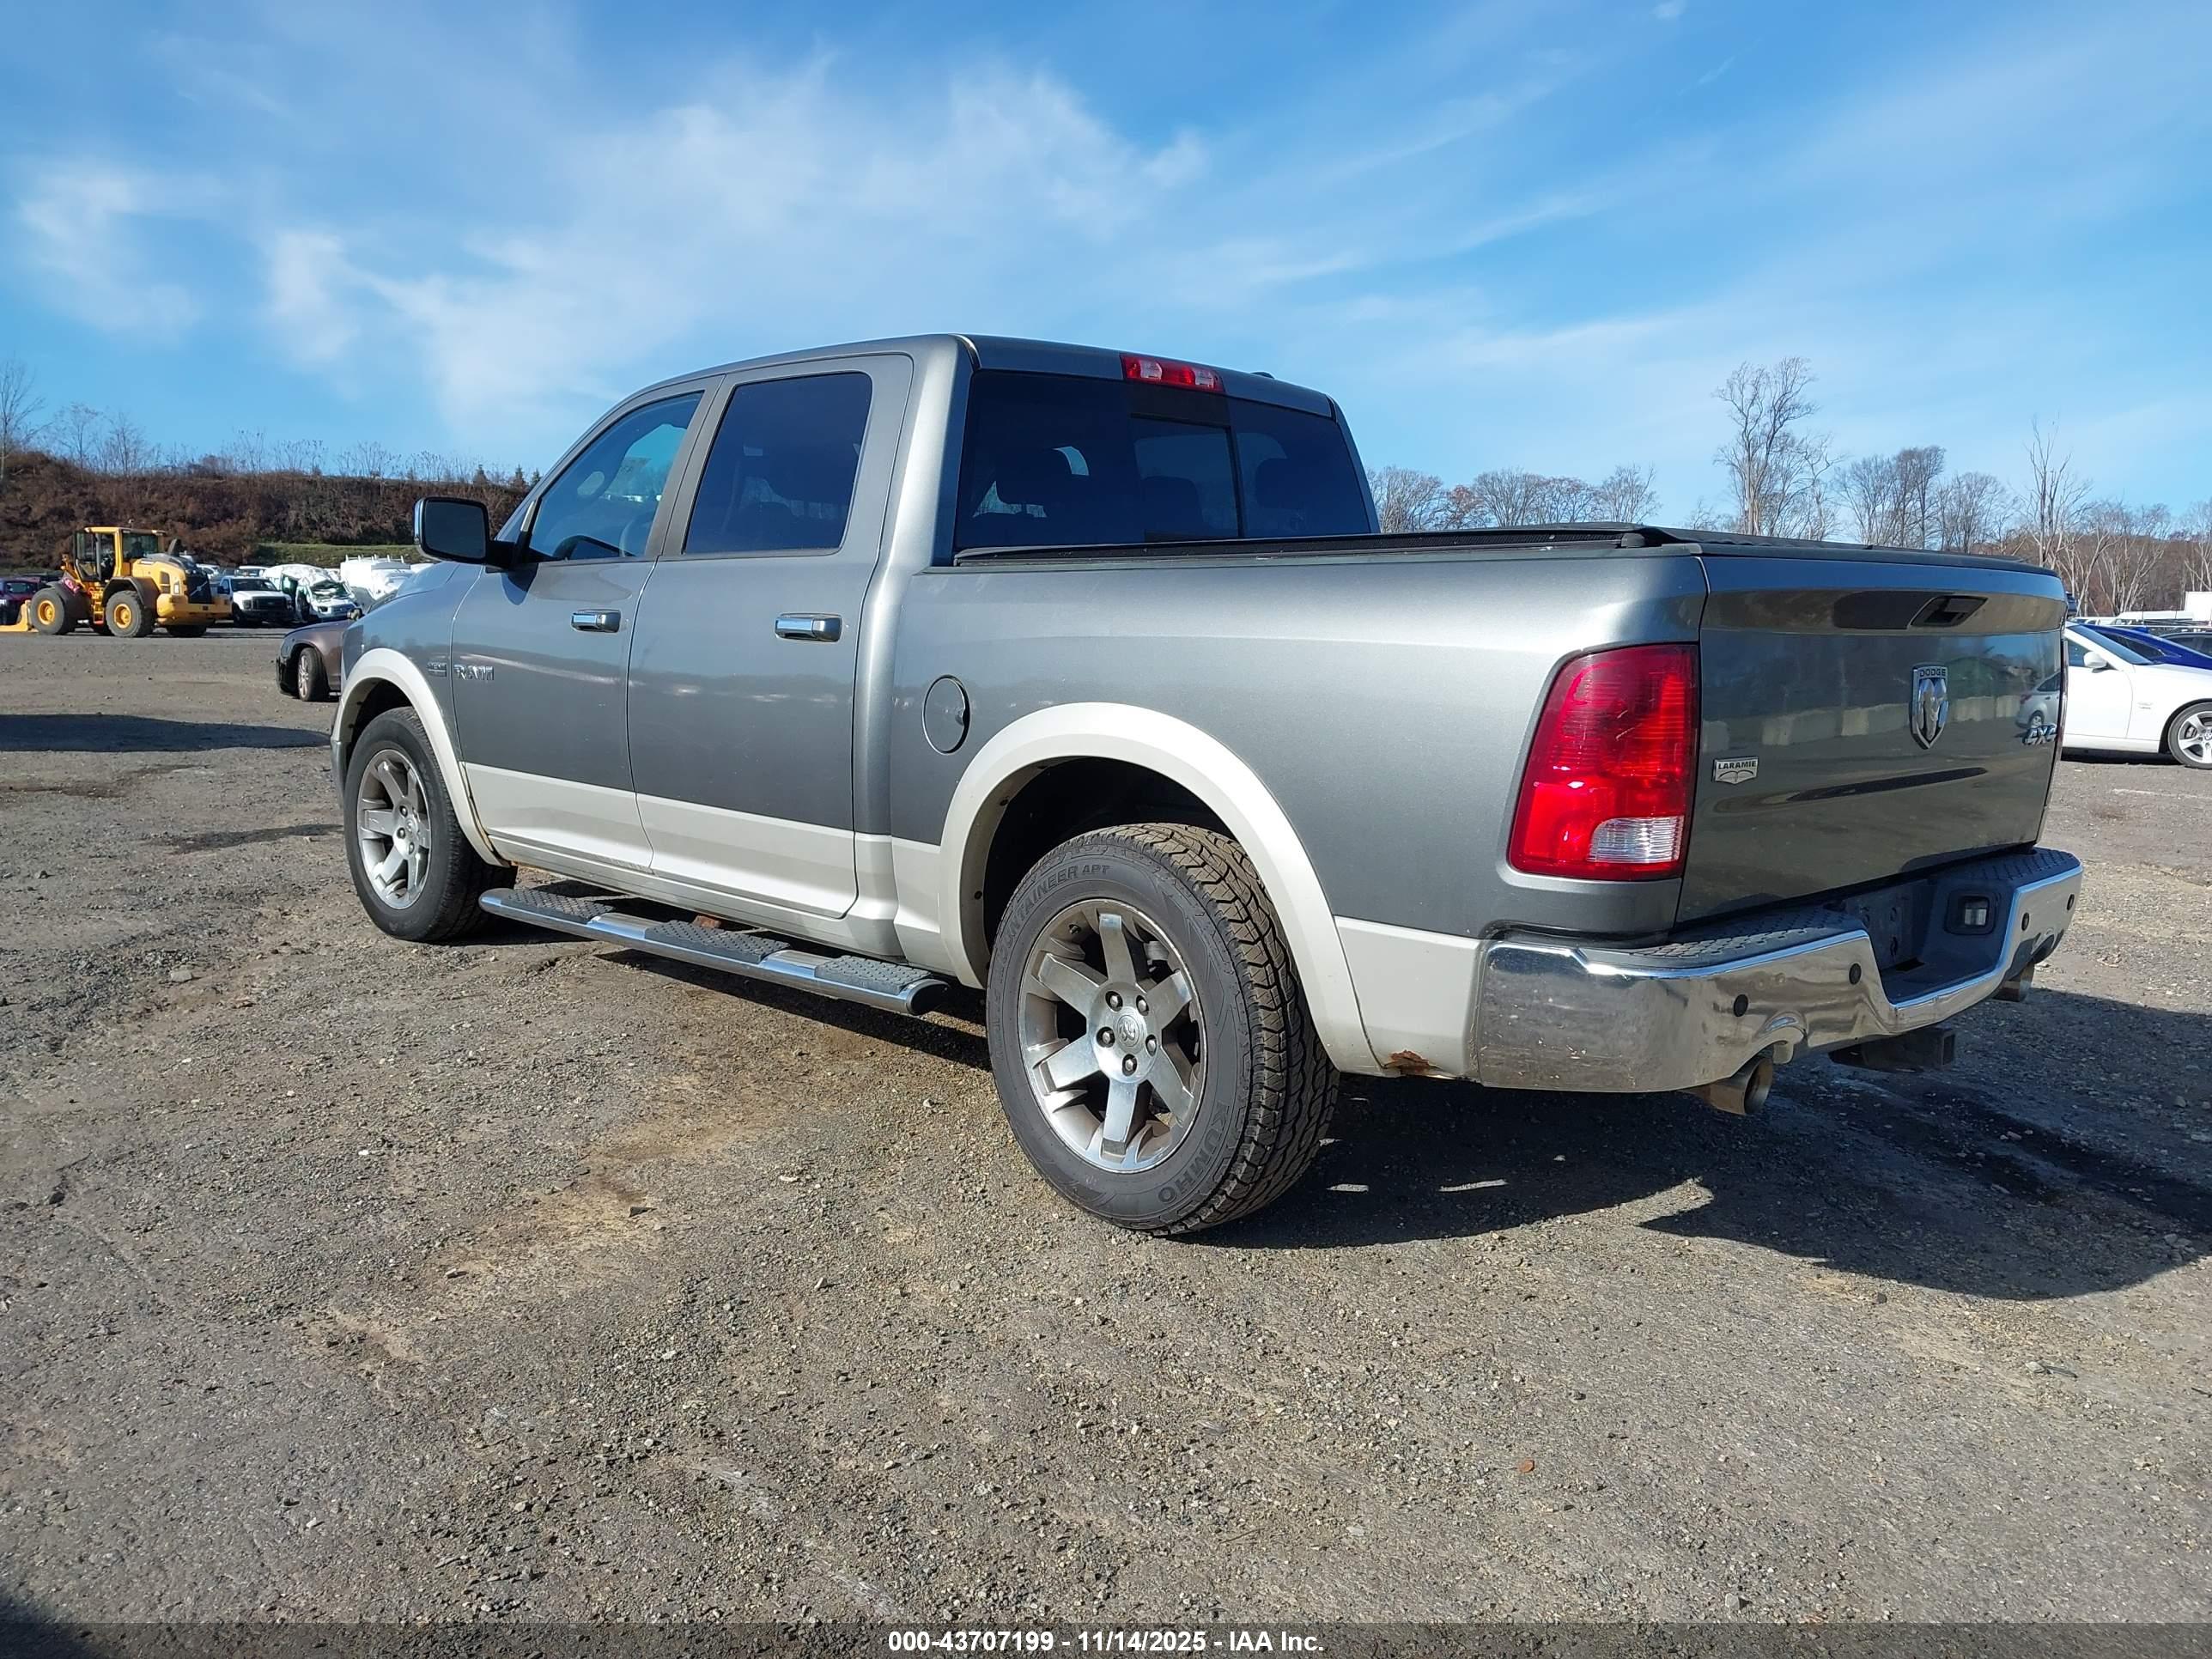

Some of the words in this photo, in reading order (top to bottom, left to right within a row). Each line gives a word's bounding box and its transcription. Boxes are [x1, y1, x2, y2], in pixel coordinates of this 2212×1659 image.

[453, 664, 495, 681] RAM
[1918, 667, 1947, 678] DODGE
[1717, 760, 1757, 770] LARAMIE
[1158, 1099, 1231, 1203] KUMHO
